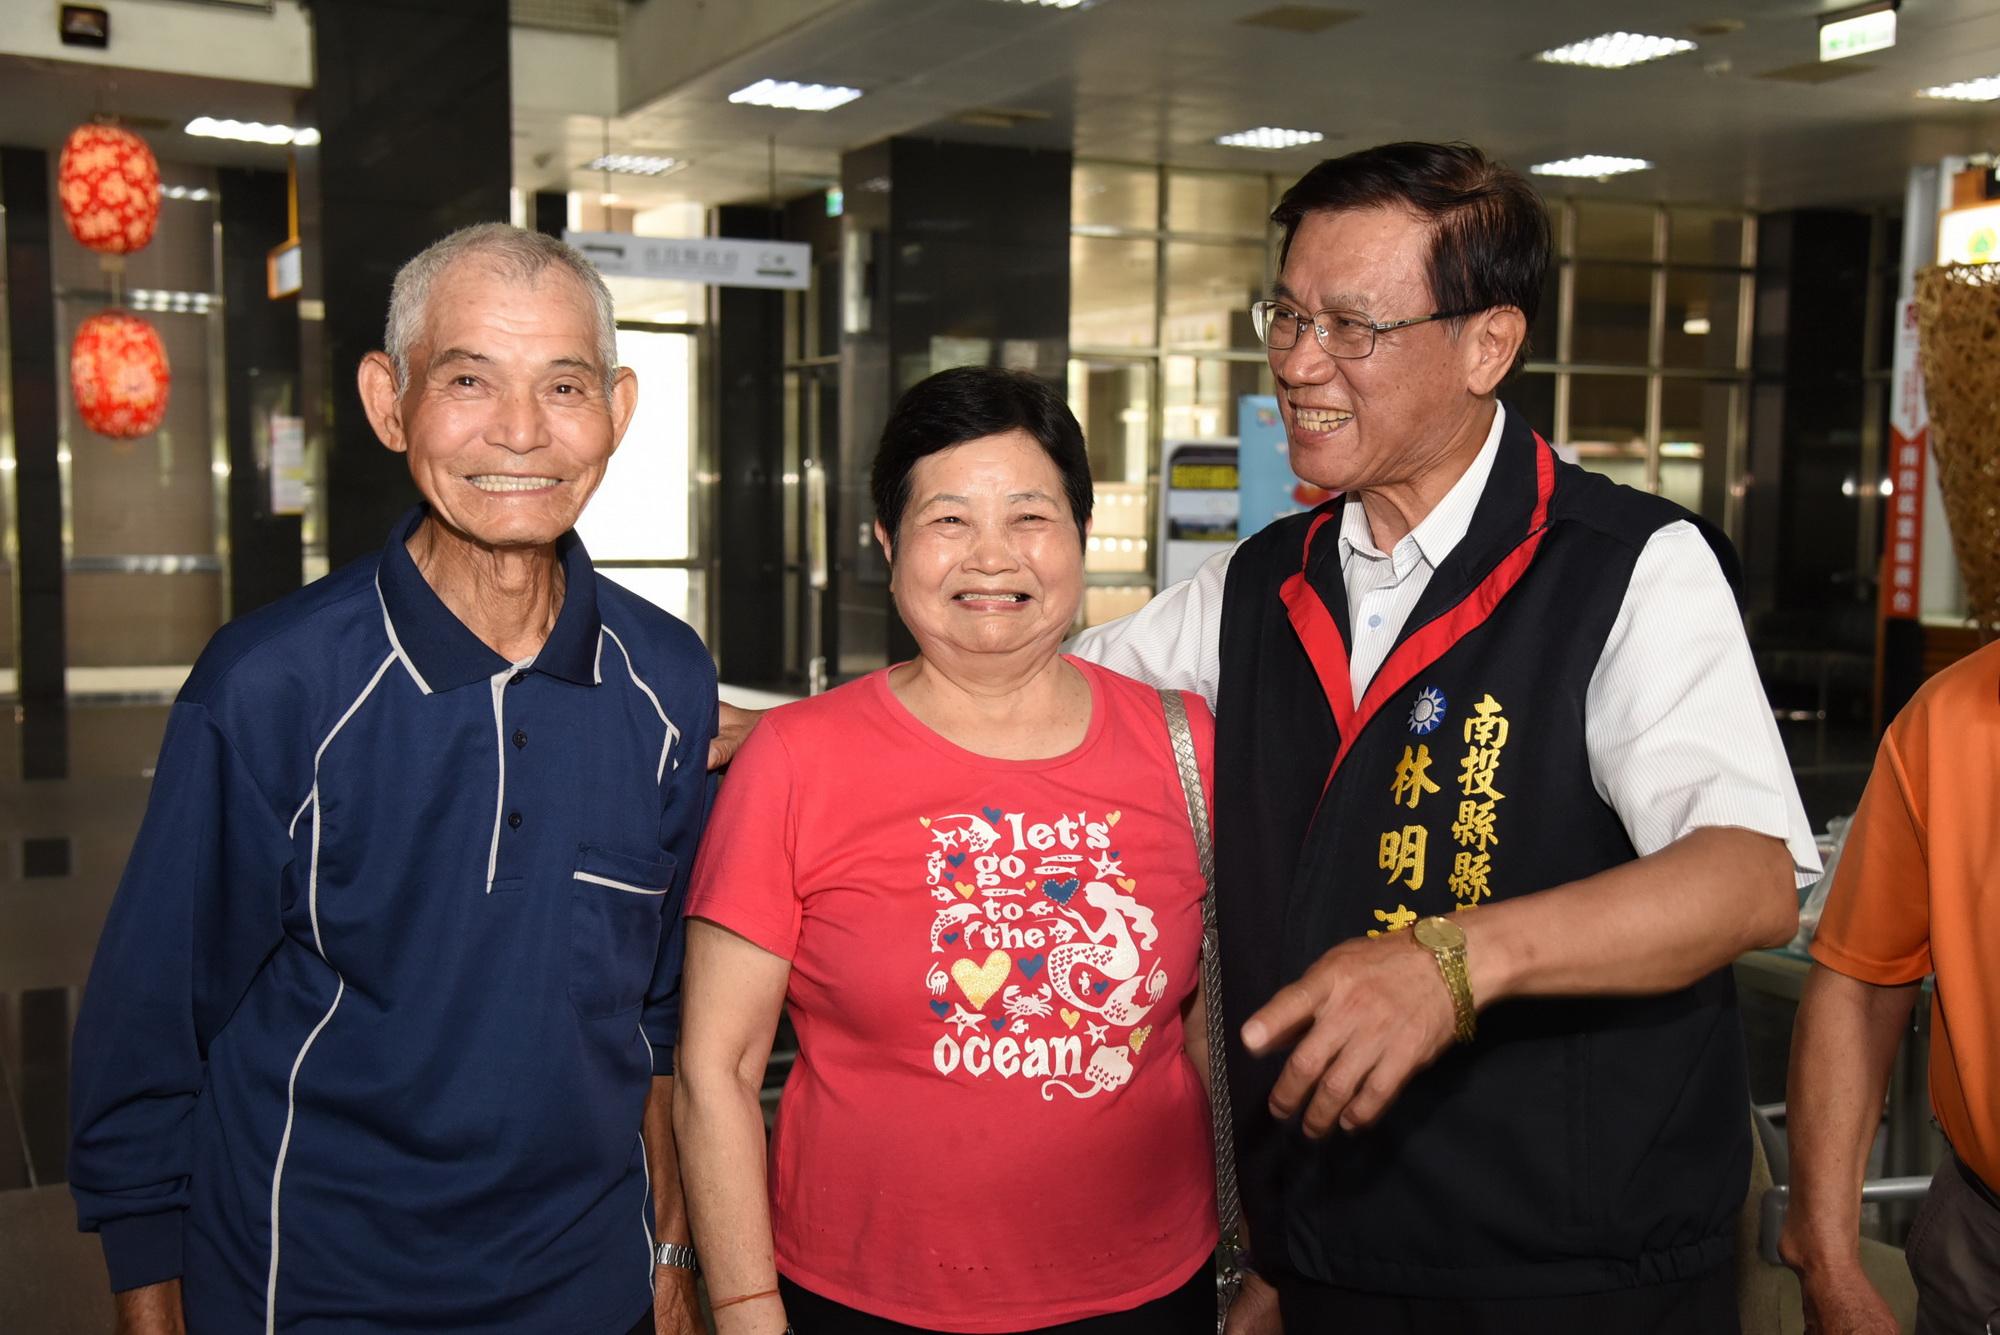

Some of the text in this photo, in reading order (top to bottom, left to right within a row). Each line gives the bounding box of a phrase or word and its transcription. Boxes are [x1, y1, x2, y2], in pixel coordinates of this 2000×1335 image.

[1448, 693, 1509, 912] 南投縣縣
[1004, 811, 1111, 853] let's
[974, 852, 1026, 889] go
[982, 897, 1024, 923] to
[980, 922, 1046, 950] the
[933, 1033, 1083, 1079] ocean
